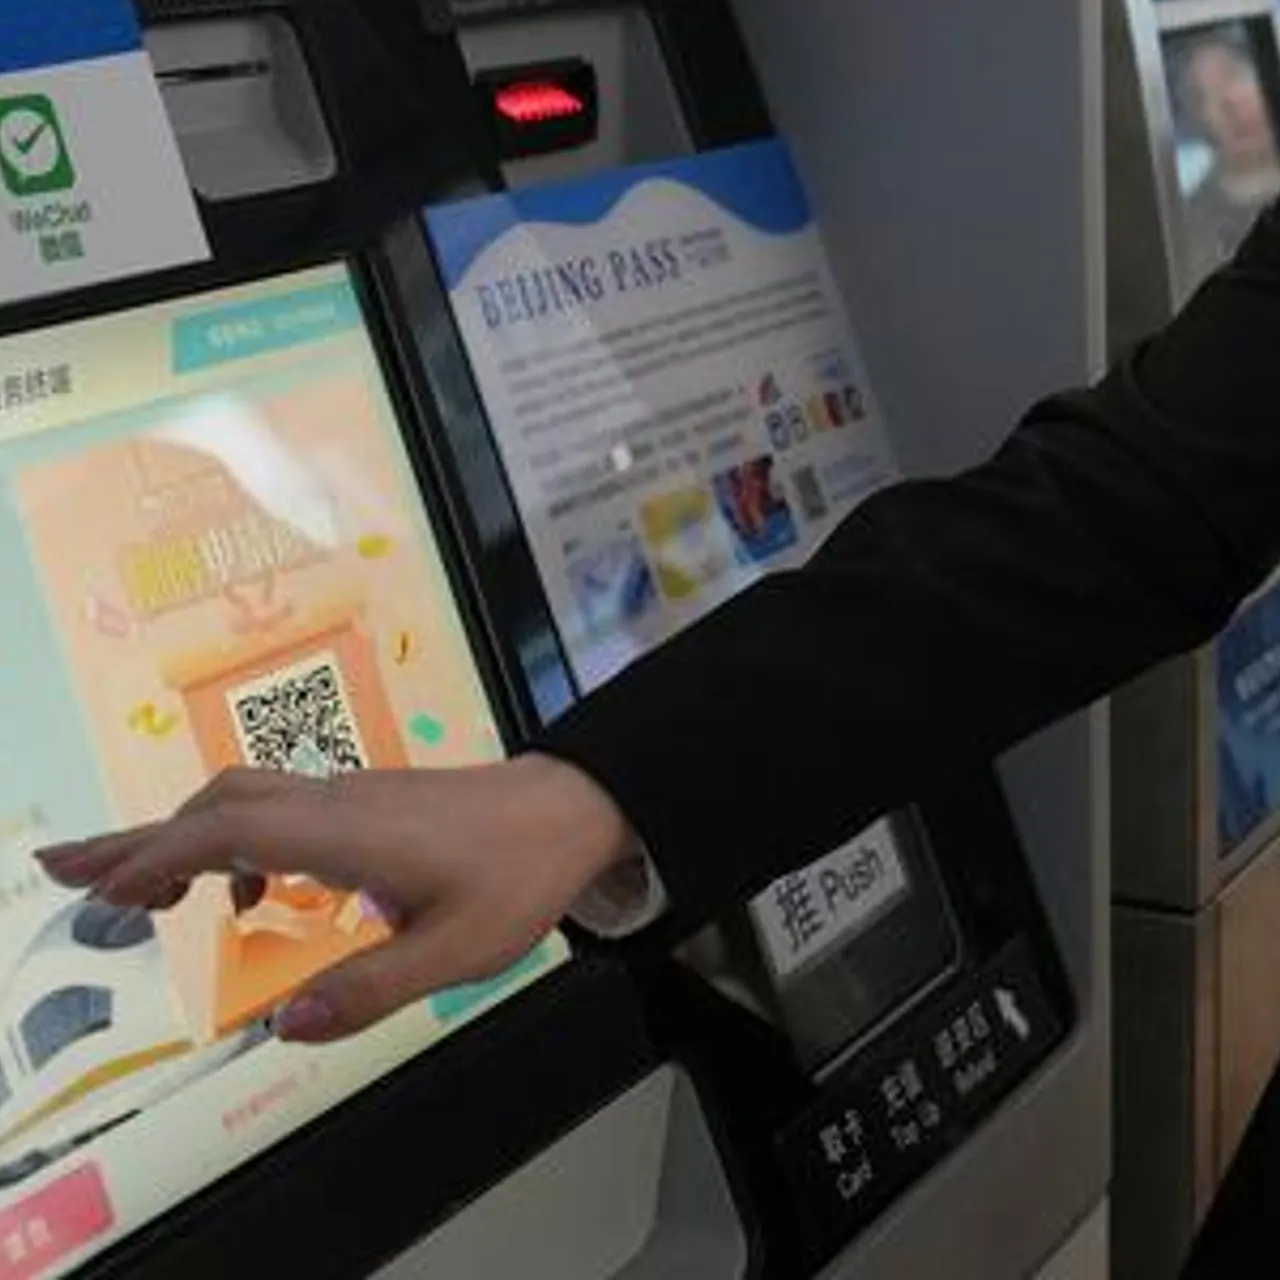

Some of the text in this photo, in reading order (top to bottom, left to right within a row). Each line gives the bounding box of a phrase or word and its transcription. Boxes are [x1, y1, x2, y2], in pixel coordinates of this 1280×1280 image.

[475, 256, 605, 328] BEIJING
[607, 236, 683, 291] PASS
[821, 847, 886, 912] Push
